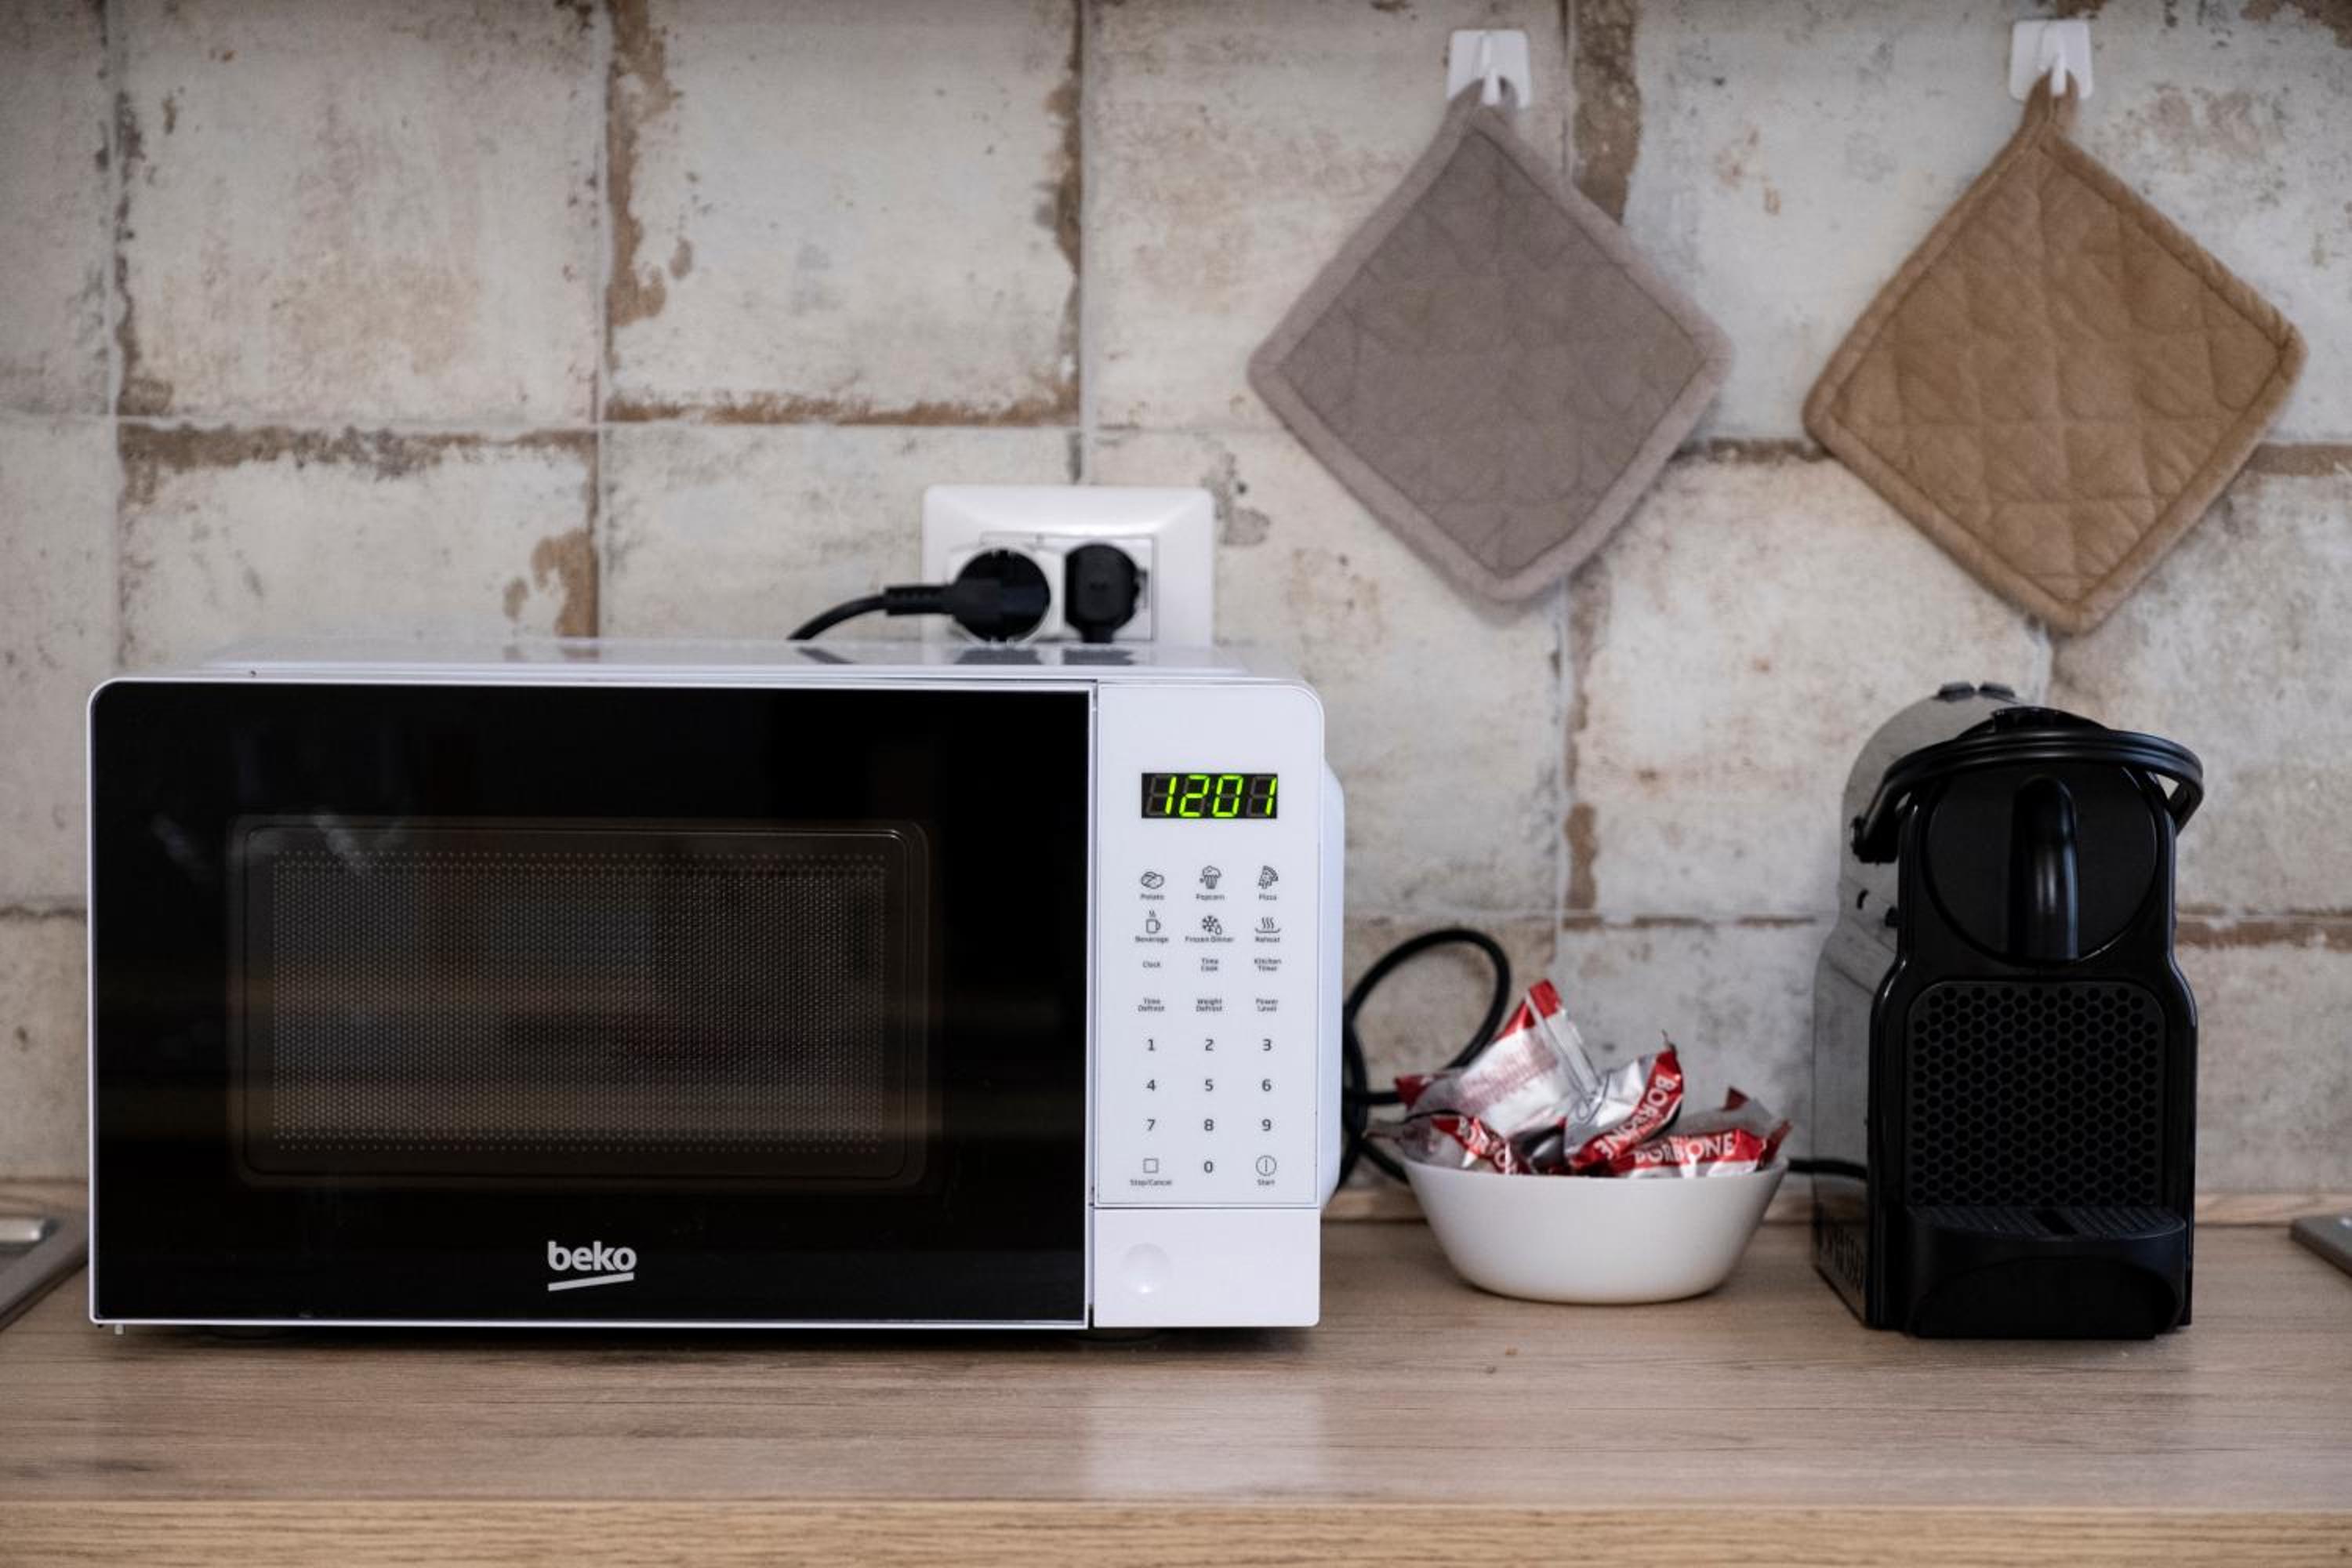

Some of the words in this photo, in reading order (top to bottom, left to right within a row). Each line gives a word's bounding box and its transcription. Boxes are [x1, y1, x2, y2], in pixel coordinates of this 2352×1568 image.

[1134, 935, 1169, 944] Beverage
[1142, 960, 1161, 969] Clock
[1258, 1004, 1277, 1013] Level
[1148, 1039, 1156, 1051] 1
[1205, 1039, 1214, 1051] 2
[1263, 1039, 1272, 1051] 3
[1146, 1080, 1156, 1091] 4
[1205, 1079, 1214, 1091] 5
[1261, 1079, 1272, 1091] 6
[1147, 1119, 1156, 1131] 7
[1204, 1119, 1214, 1131] 8
[1261, 1119, 1272, 1131] 9
[1203, 1160, 1214, 1174] 0
[1130, 1178, 1173, 1187] Stop/Cancel
[547, 1240, 637, 1272] beko
